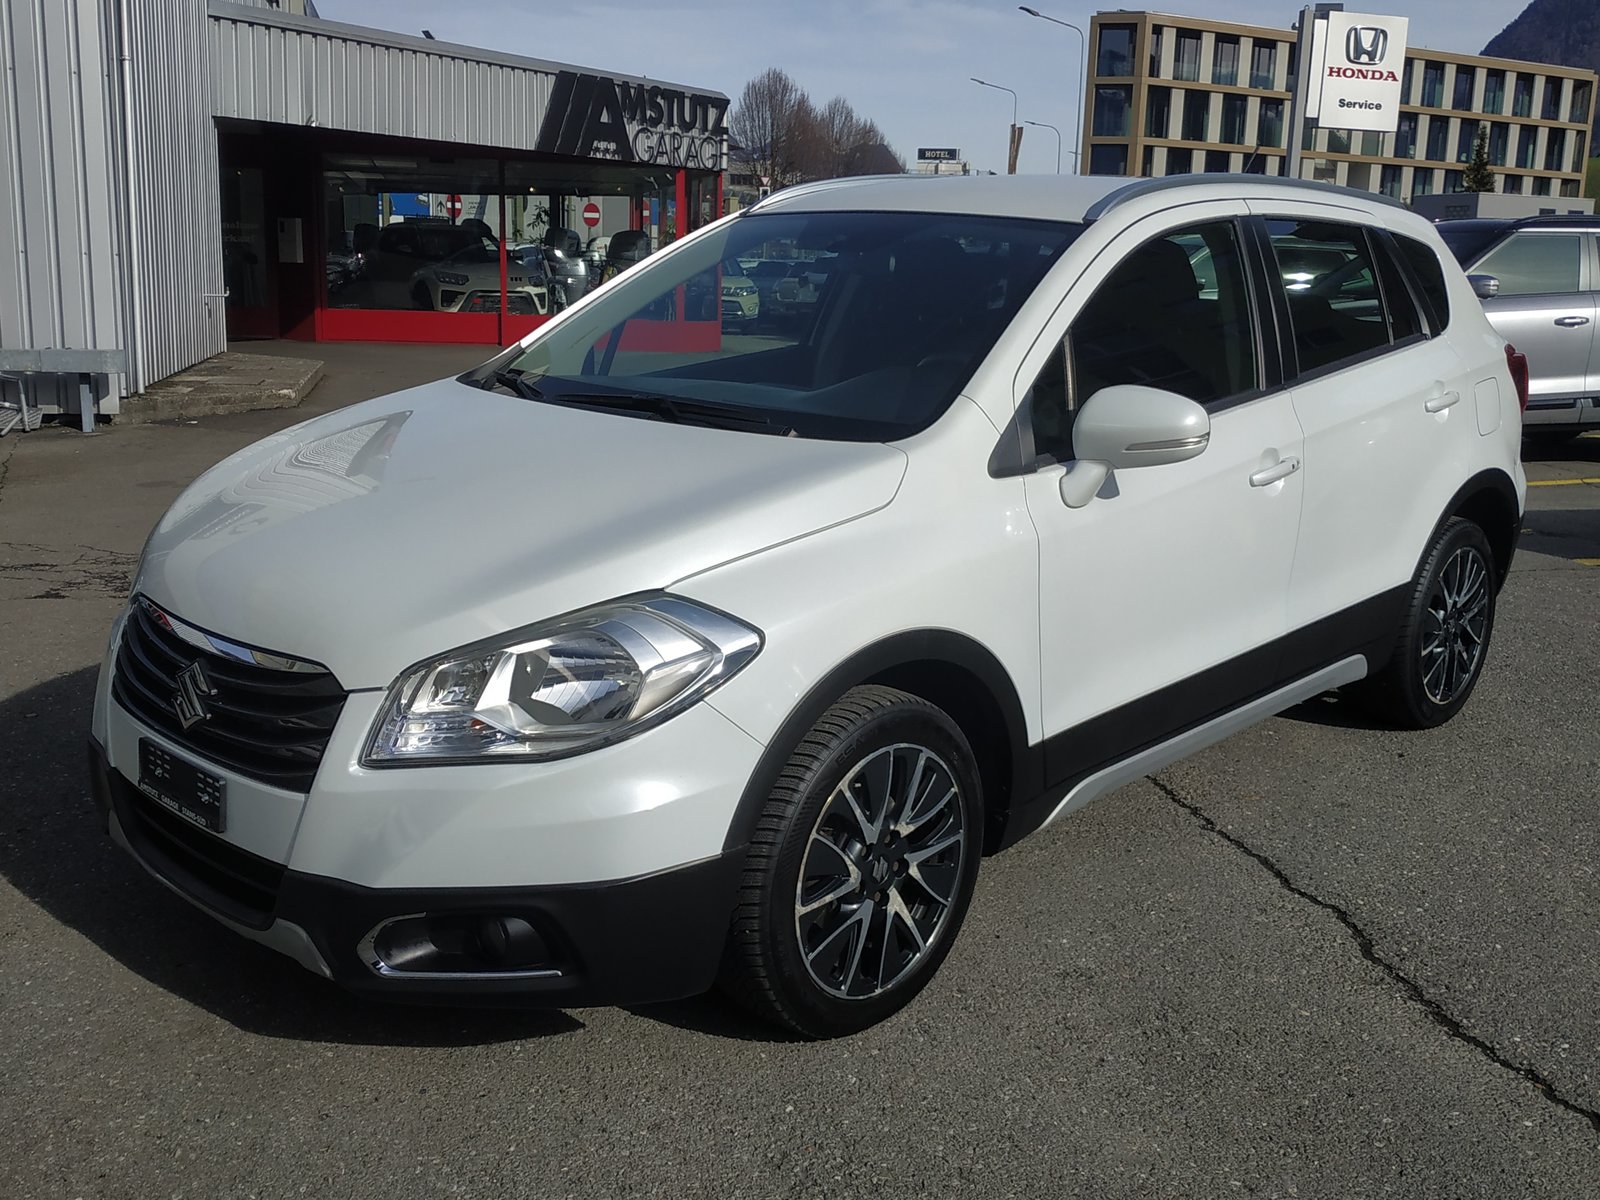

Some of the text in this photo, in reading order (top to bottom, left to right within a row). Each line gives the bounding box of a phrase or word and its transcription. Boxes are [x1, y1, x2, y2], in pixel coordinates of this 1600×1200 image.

[1327, 66, 1399, 82] HONDA
[574, 76, 730, 161] AMSTUTZ
[1338, 98, 1382, 111] Service
[632, 127, 728, 171] GARAGE
